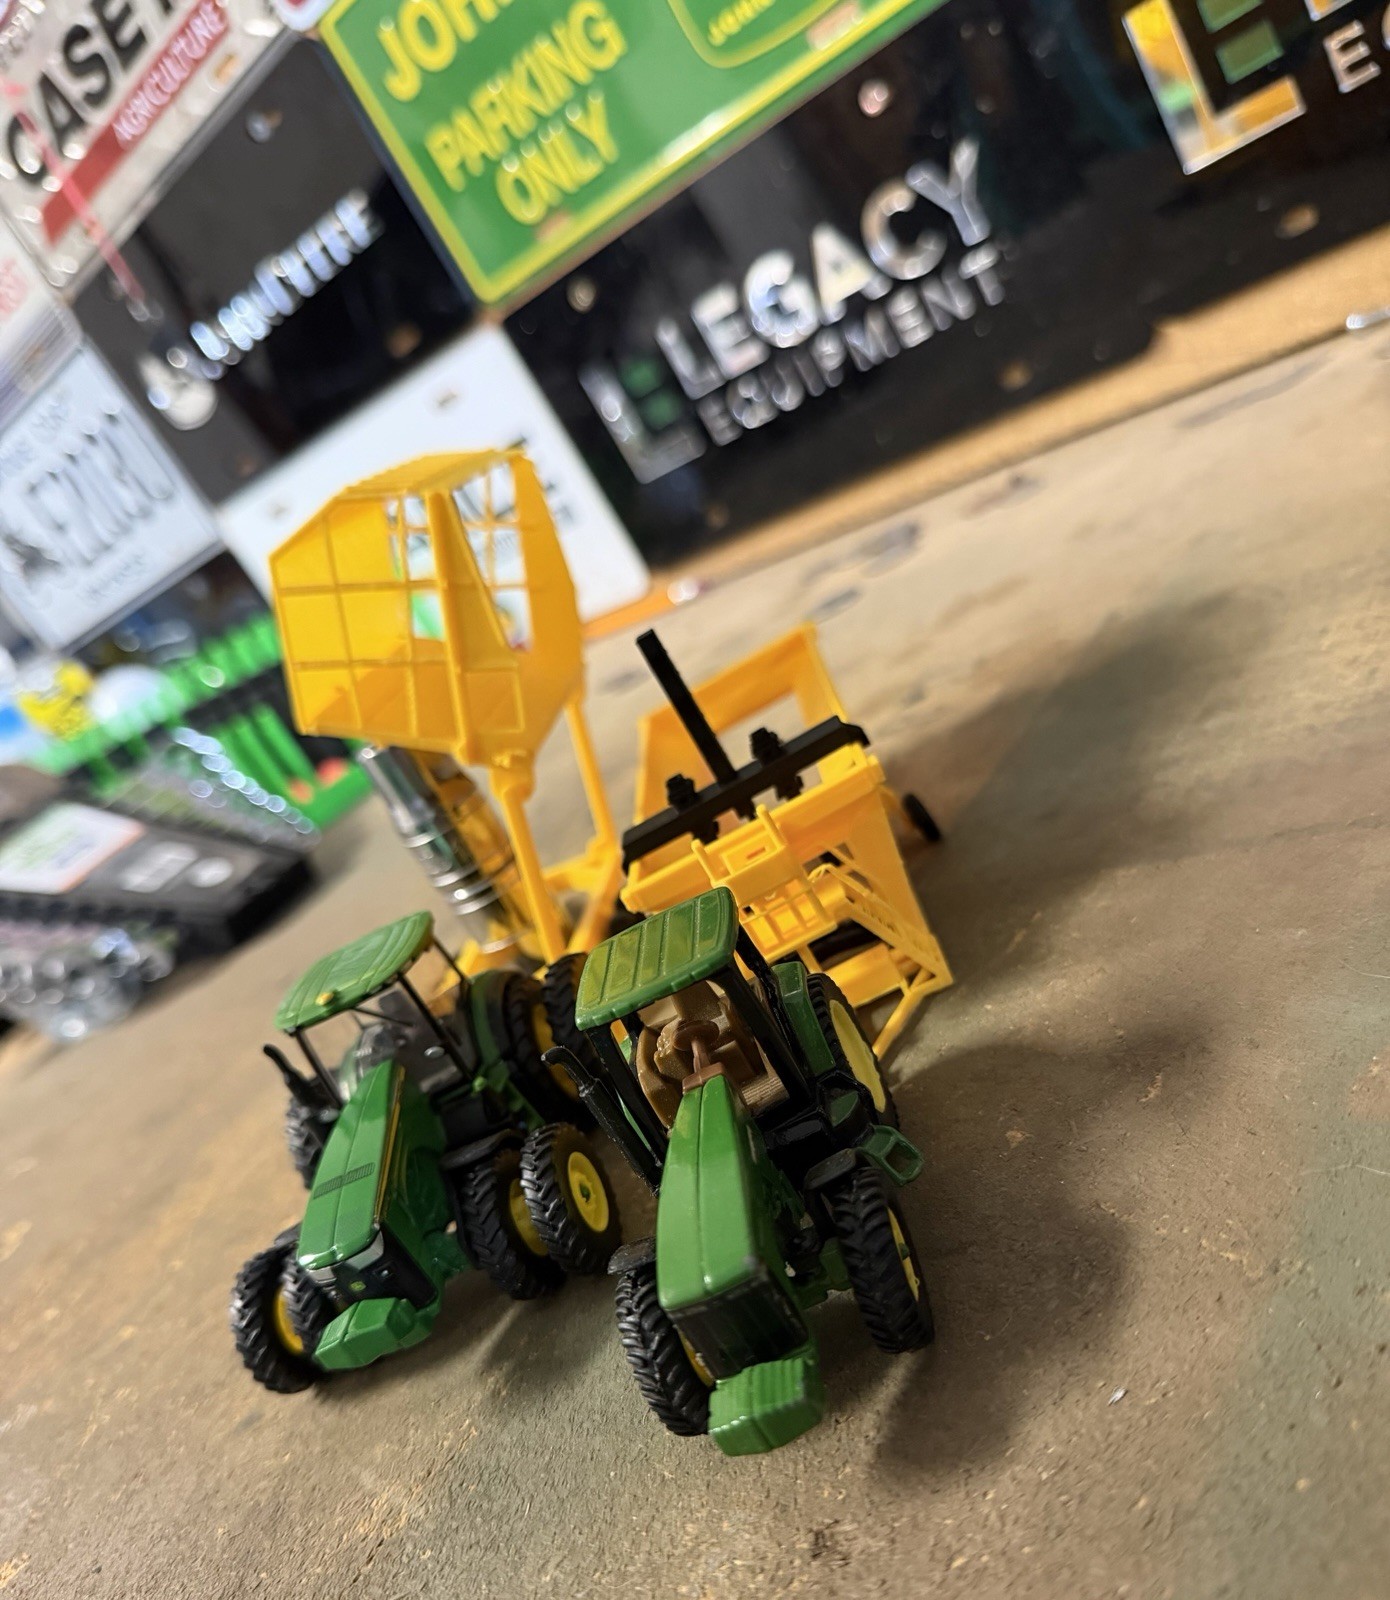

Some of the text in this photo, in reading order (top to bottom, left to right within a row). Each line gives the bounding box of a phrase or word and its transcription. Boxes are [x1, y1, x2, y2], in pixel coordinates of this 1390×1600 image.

[8, 0, 147, 184] CASE
[425, 1, 626, 191] PARKING
[496, 89, 619, 224] ONLY
[655, 137, 990, 400] LEGACY
[695, 242, 1004, 447] EQUIPMENT
